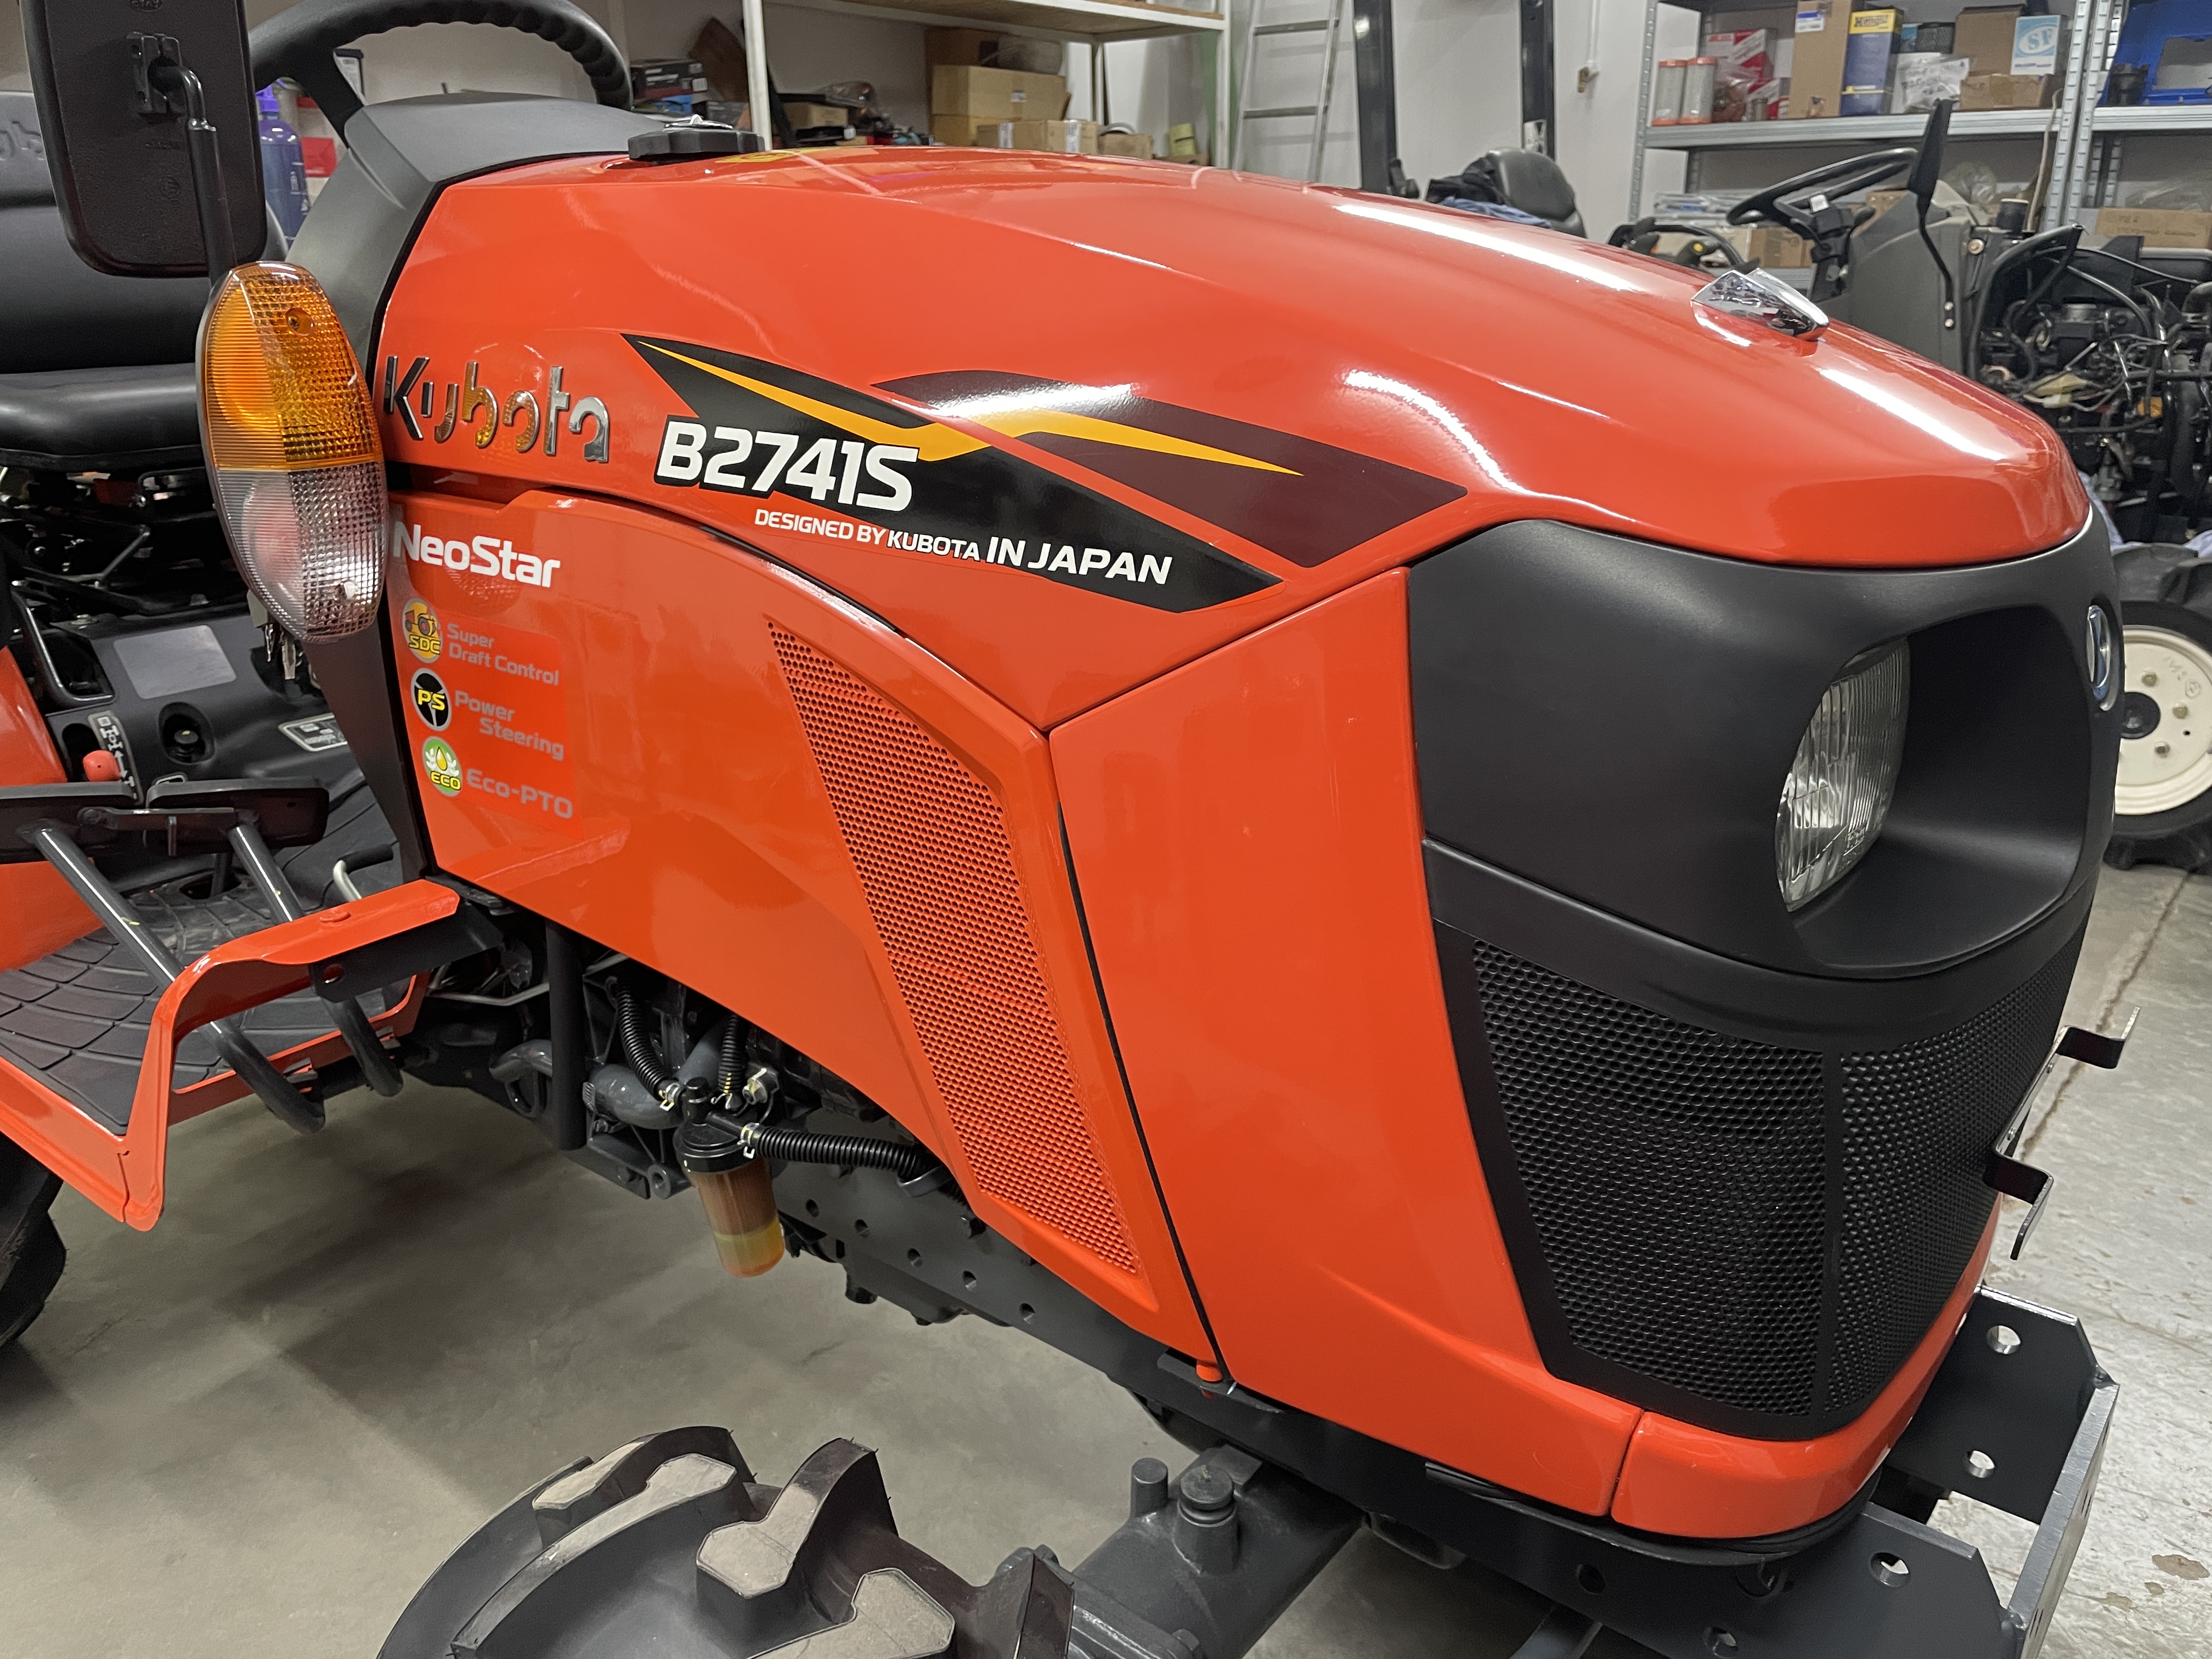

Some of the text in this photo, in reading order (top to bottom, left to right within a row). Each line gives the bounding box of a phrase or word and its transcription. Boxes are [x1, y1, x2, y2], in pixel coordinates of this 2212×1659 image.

[384, 356, 610, 463] Kubota
[657, 420, 919, 512] B2741S
[393, 521, 561, 588] NeoStar
[754, 509, 1173, 585] DESIGNED BY KUBOTA IN JAPAN
[409, 635, 441, 654] SDC
[447, 623, 494, 649] Super
[449, 642, 559, 686] Draft Control
[417, 689, 445, 712] PS
[454, 690, 515, 721] Power
[479, 718, 565, 761] Steering
[430, 771, 461, 791] ECO
[466, 769, 573, 819] Eco-PTO
